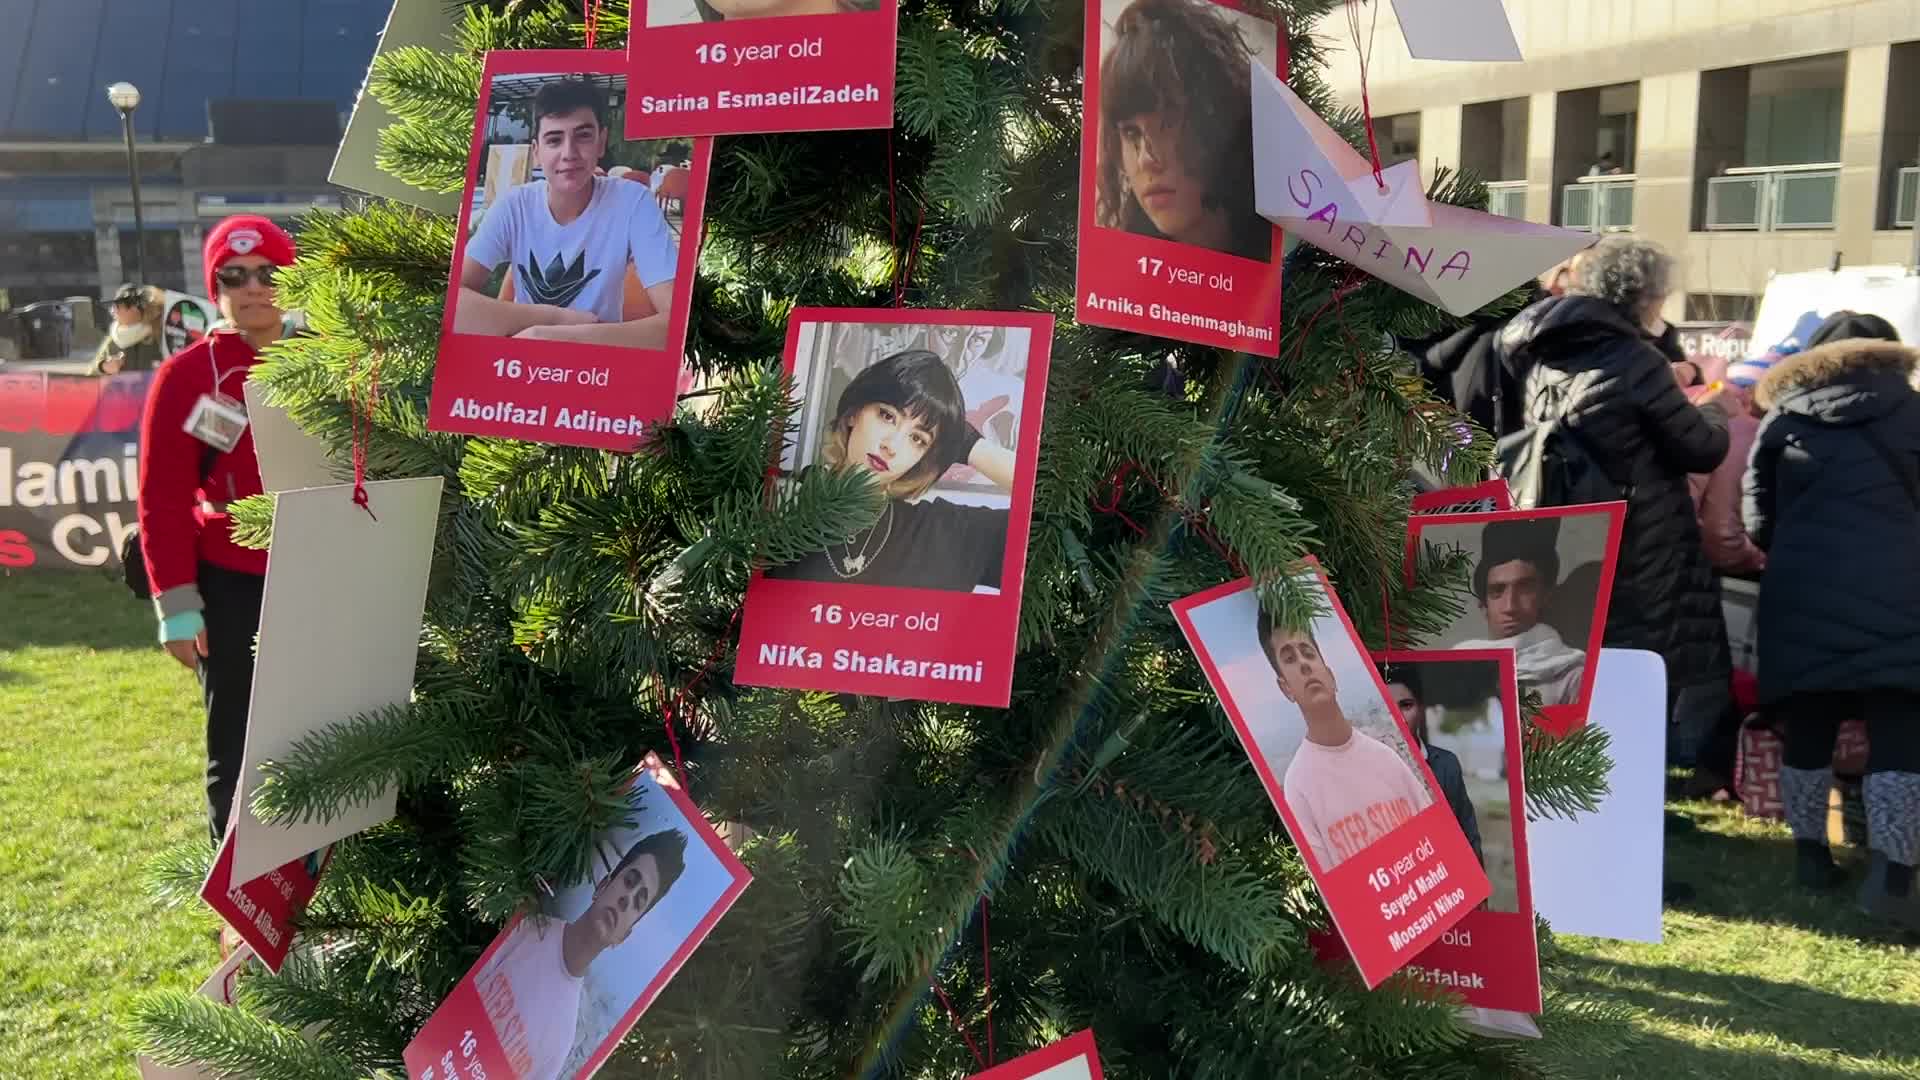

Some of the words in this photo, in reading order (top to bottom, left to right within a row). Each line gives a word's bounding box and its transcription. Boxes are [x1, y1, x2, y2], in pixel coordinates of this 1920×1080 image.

[696, 43, 727, 64] 16
[733, 43, 783, 66] year
[788, 37, 823, 58] old
[641, 94, 709, 114] Sarina
[717, 83, 879, 109] EsmaeilZadeh
[1287, 169, 1471, 281] SARINA
[1137, 256, 1163, 277] 17
[1167, 266, 1204, 286] year
[1209, 273, 1233, 292] old
[1086, 292, 1144, 317] Arnika
[1149, 303, 1272, 341] Ghaemmaghami
[493, 358, 522, 379] 16
[526, 366, 573, 385] year
[577, 368, 610, 387] old
[449, 397, 547, 426] Abolfazl
[554, 408, 643, 436] Adineh
[810, 603, 842, 624] 16
[848, 611, 899, 630] year
[904, 611, 939, 632] old
[758, 643, 823, 669] NiKa
[833, 649, 983, 683] Shakarami
[1368, 867, 1390, 892] 16
[1389, 853, 1416, 885] year
[1415, 836, 1434, 862] old
[1380, 884, 1418, 921] Seyed
[1415, 861, 1448, 896] Mahdi
[1388, 906, 1437, 953] Moosavi
[1434, 888, 1465, 918] Nikoo
[1442, 928, 1471, 947] old
[460, 1029, 477, 1058] 16
